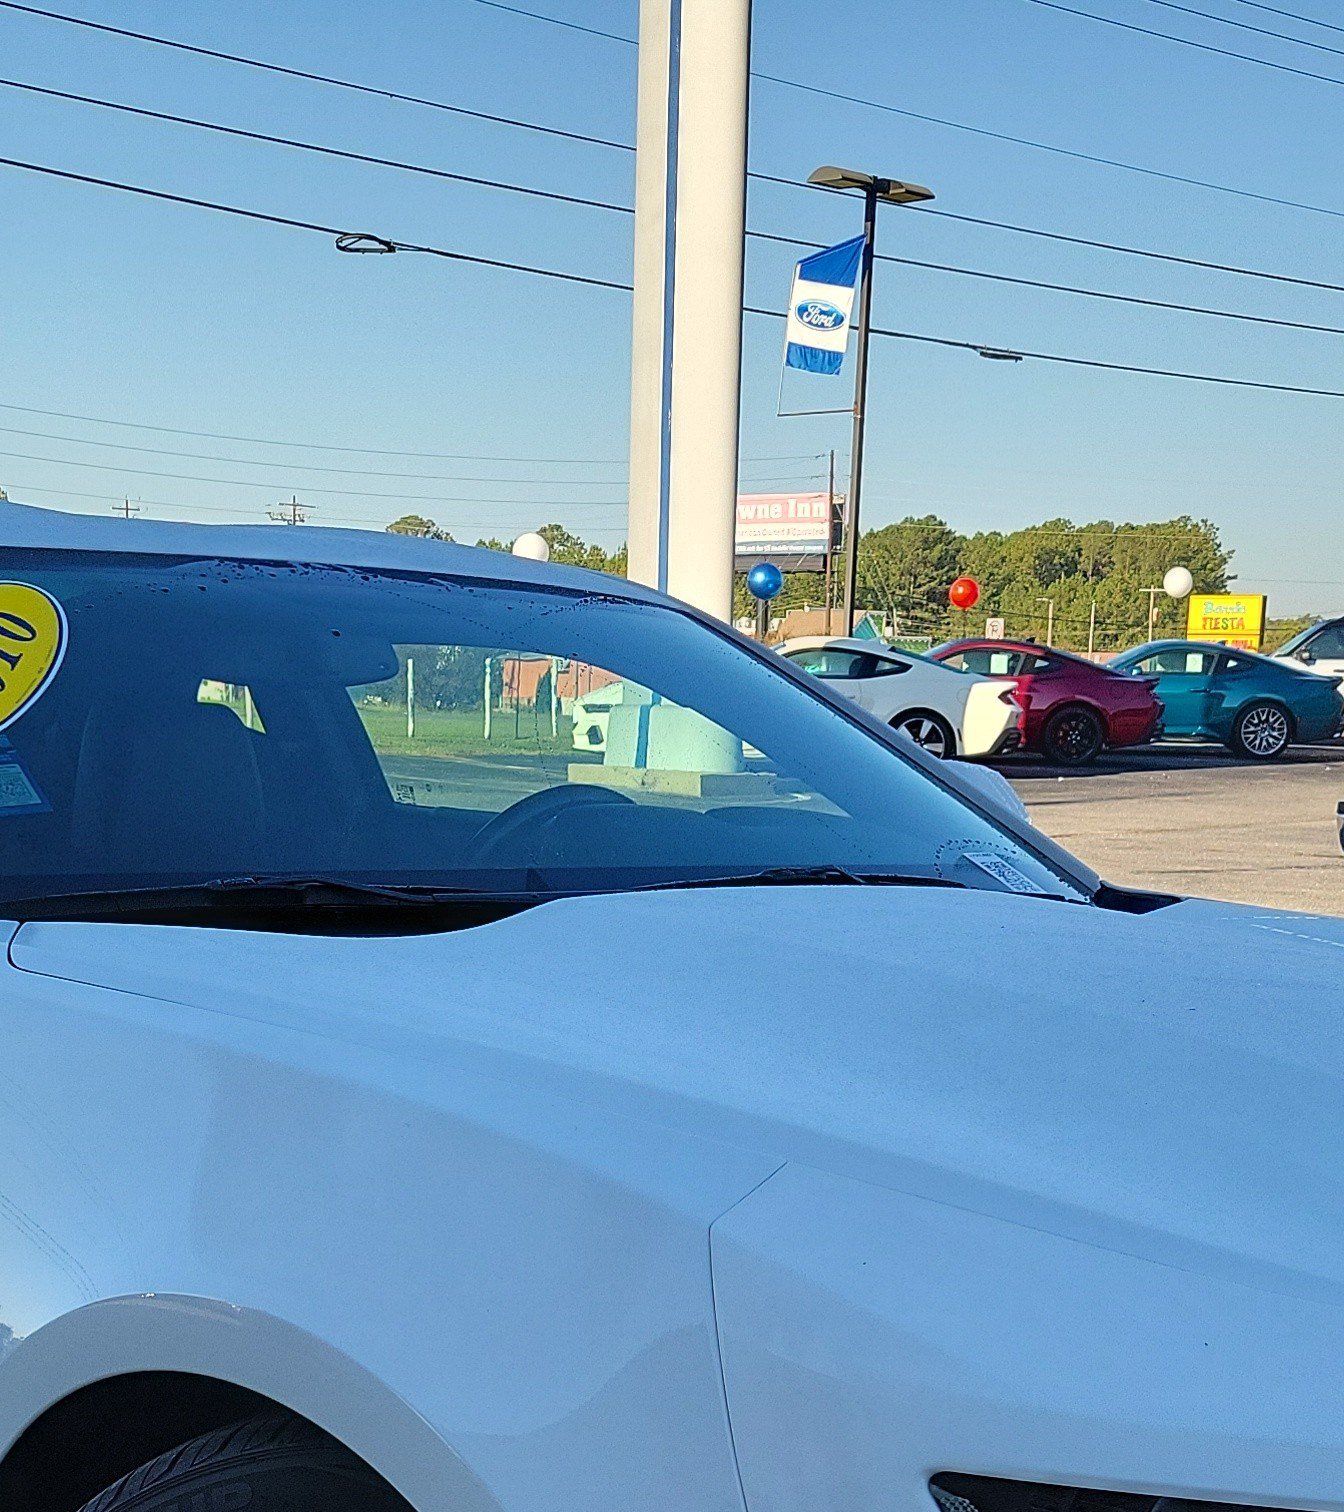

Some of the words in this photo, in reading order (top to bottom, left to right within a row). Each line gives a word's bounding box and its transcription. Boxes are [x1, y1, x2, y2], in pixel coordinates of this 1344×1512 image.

[802, 303, 837, 328] Ford
[737, 503, 783, 520] wne
[788, 498, 826, 518] Inn
[1201, 617, 1246, 631] FIESTA
